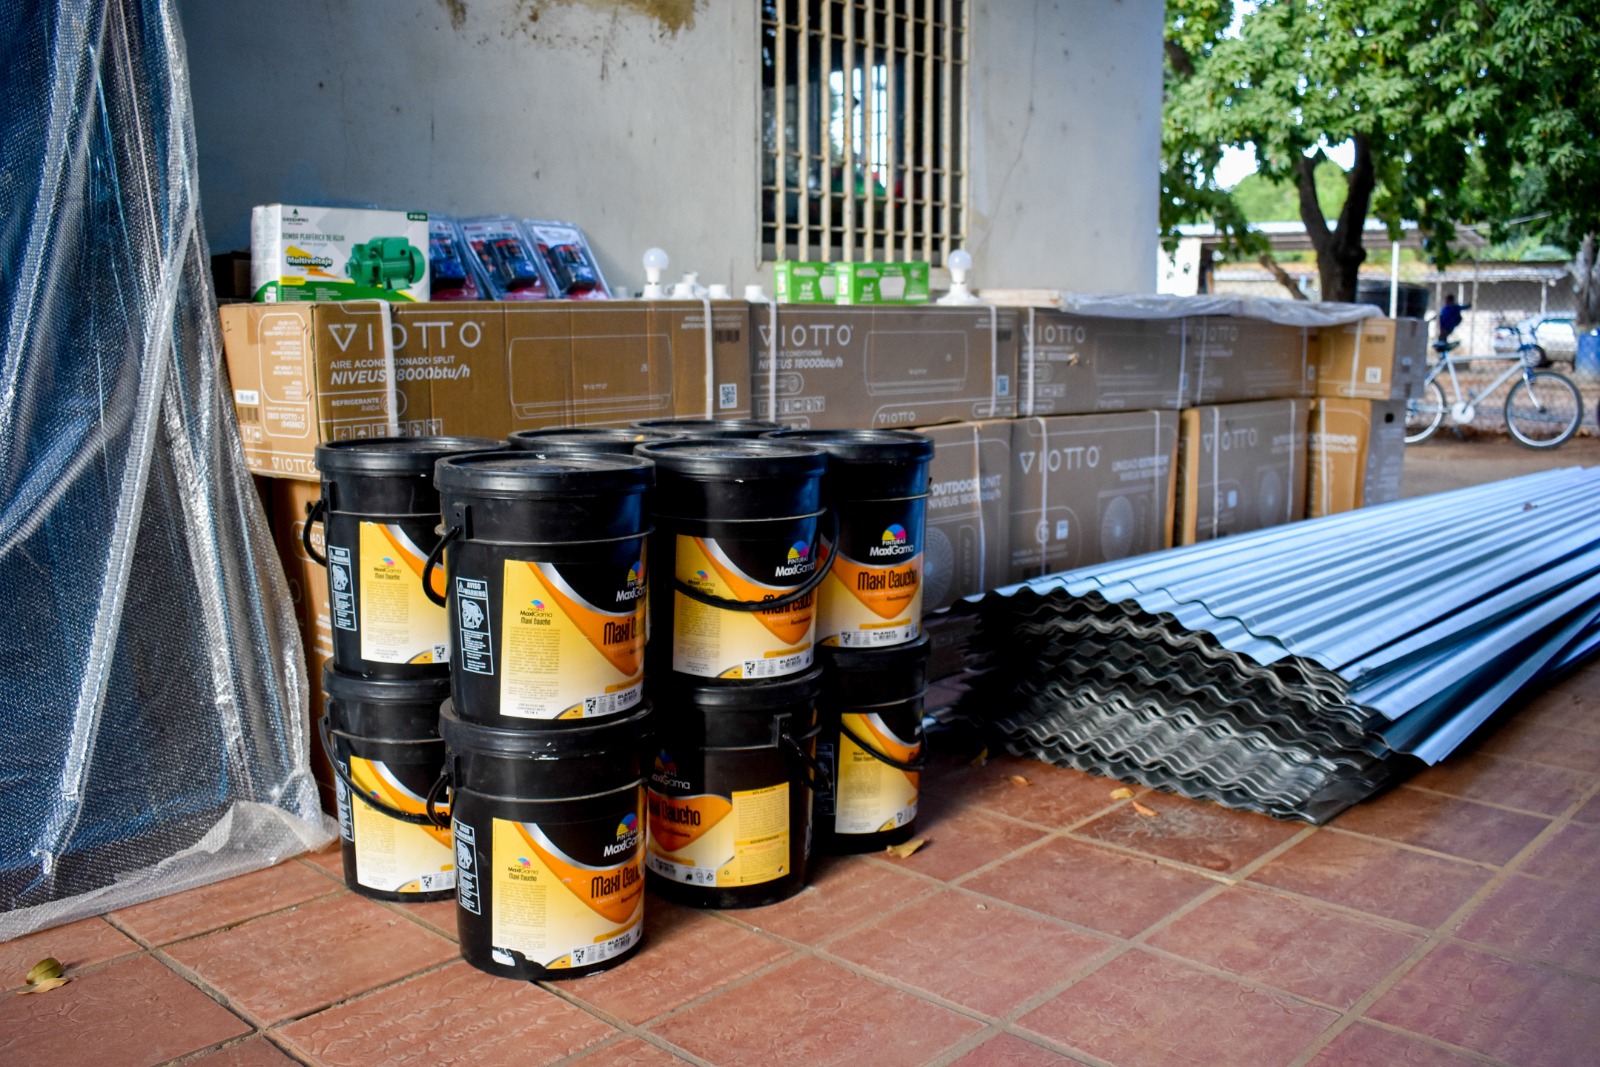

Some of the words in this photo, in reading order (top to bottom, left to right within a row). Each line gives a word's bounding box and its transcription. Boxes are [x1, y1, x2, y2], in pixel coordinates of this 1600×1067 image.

[286, 256, 333, 267] Multivoltaje
[330, 360, 352, 369] AIRE
[433, 355, 455, 364] SPLIT
[330, 369, 387, 385] NIVEUS
[392, 363, 471, 382] 8000btu/h
[331, 398, 380, 406] REFRIGERANTE
[869, 545, 914, 557] MaxiGama
[775, 561, 815, 577] MaxiGama
[466, 581, 481, 590] AVISO
[857, 570, 886, 591] Maxi
[888, 567, 917, 588] Caucho
[604, 616, 630, 645] Maxi
[591, 871, 621, 899] Maxi
